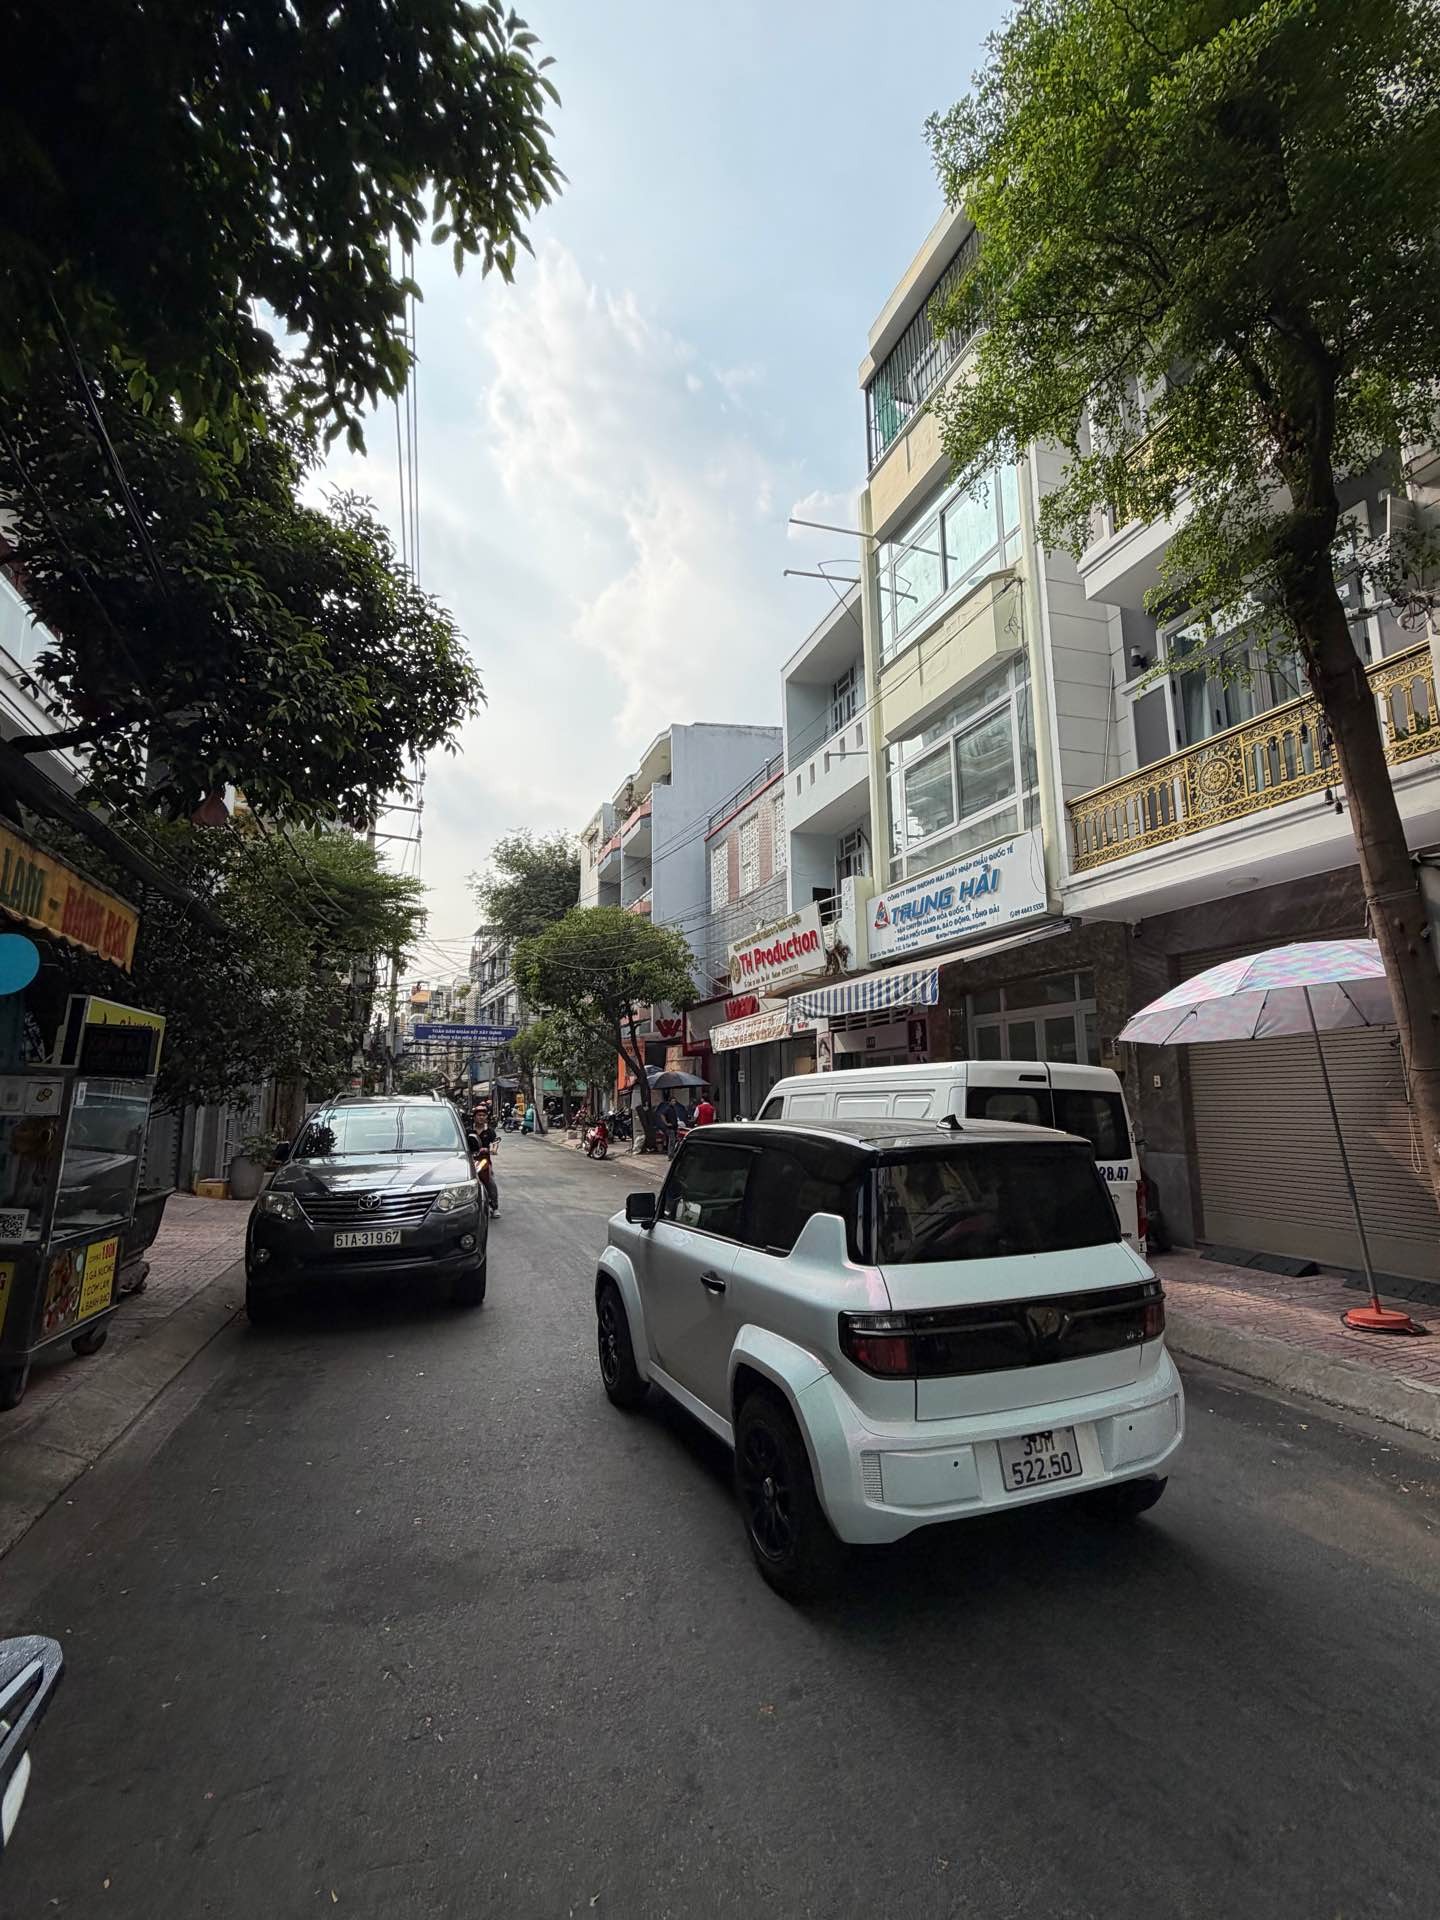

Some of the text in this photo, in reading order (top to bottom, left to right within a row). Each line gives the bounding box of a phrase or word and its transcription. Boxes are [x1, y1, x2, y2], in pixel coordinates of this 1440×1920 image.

[887, 892, 900, 902] CÔNG
[900, 890, 906, 898] TY
[988, 847, 1006, 860] QUỐC
[1006, 842, 1014, 854] TẾ
[891, 863, 1000, 926] TRUNG HẢI
[739, 951, 755, 976] TH
[753, 929, 820, 971] Production
[335, 1231, 399, 1247] 51A-319.67
[1011, 1452, 1073, 1485] 522.50
